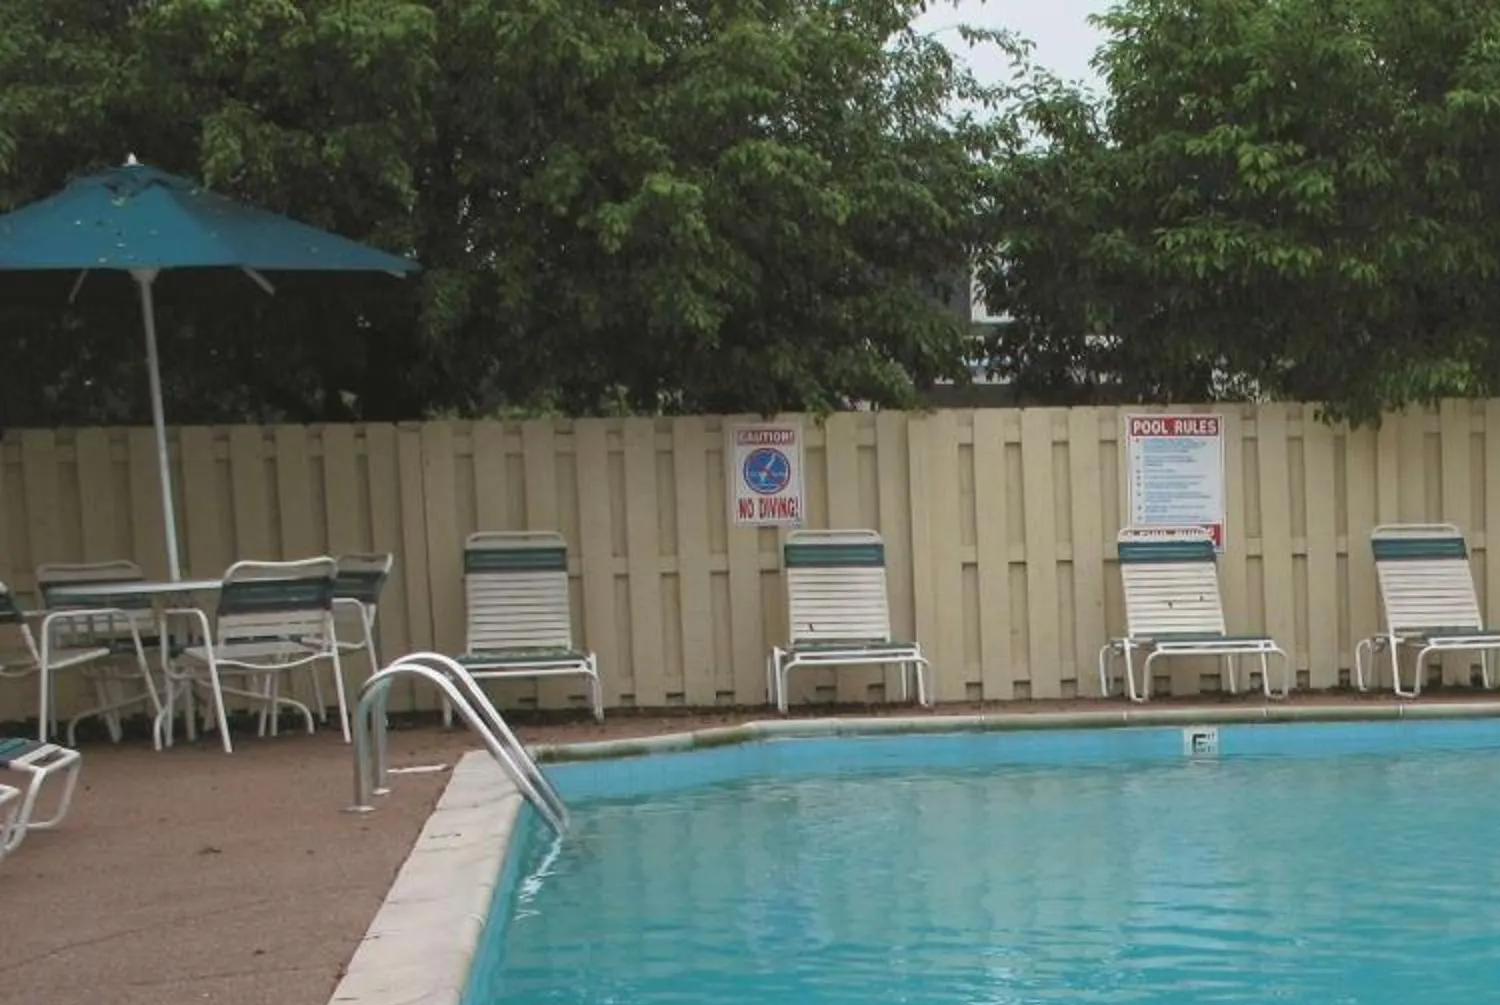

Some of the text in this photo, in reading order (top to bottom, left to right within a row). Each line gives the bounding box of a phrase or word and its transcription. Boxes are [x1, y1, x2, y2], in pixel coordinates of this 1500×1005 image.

[1132, 419, 1217, 434] POOL RULES
[738, 497, 800, 519] NO DIVING!
